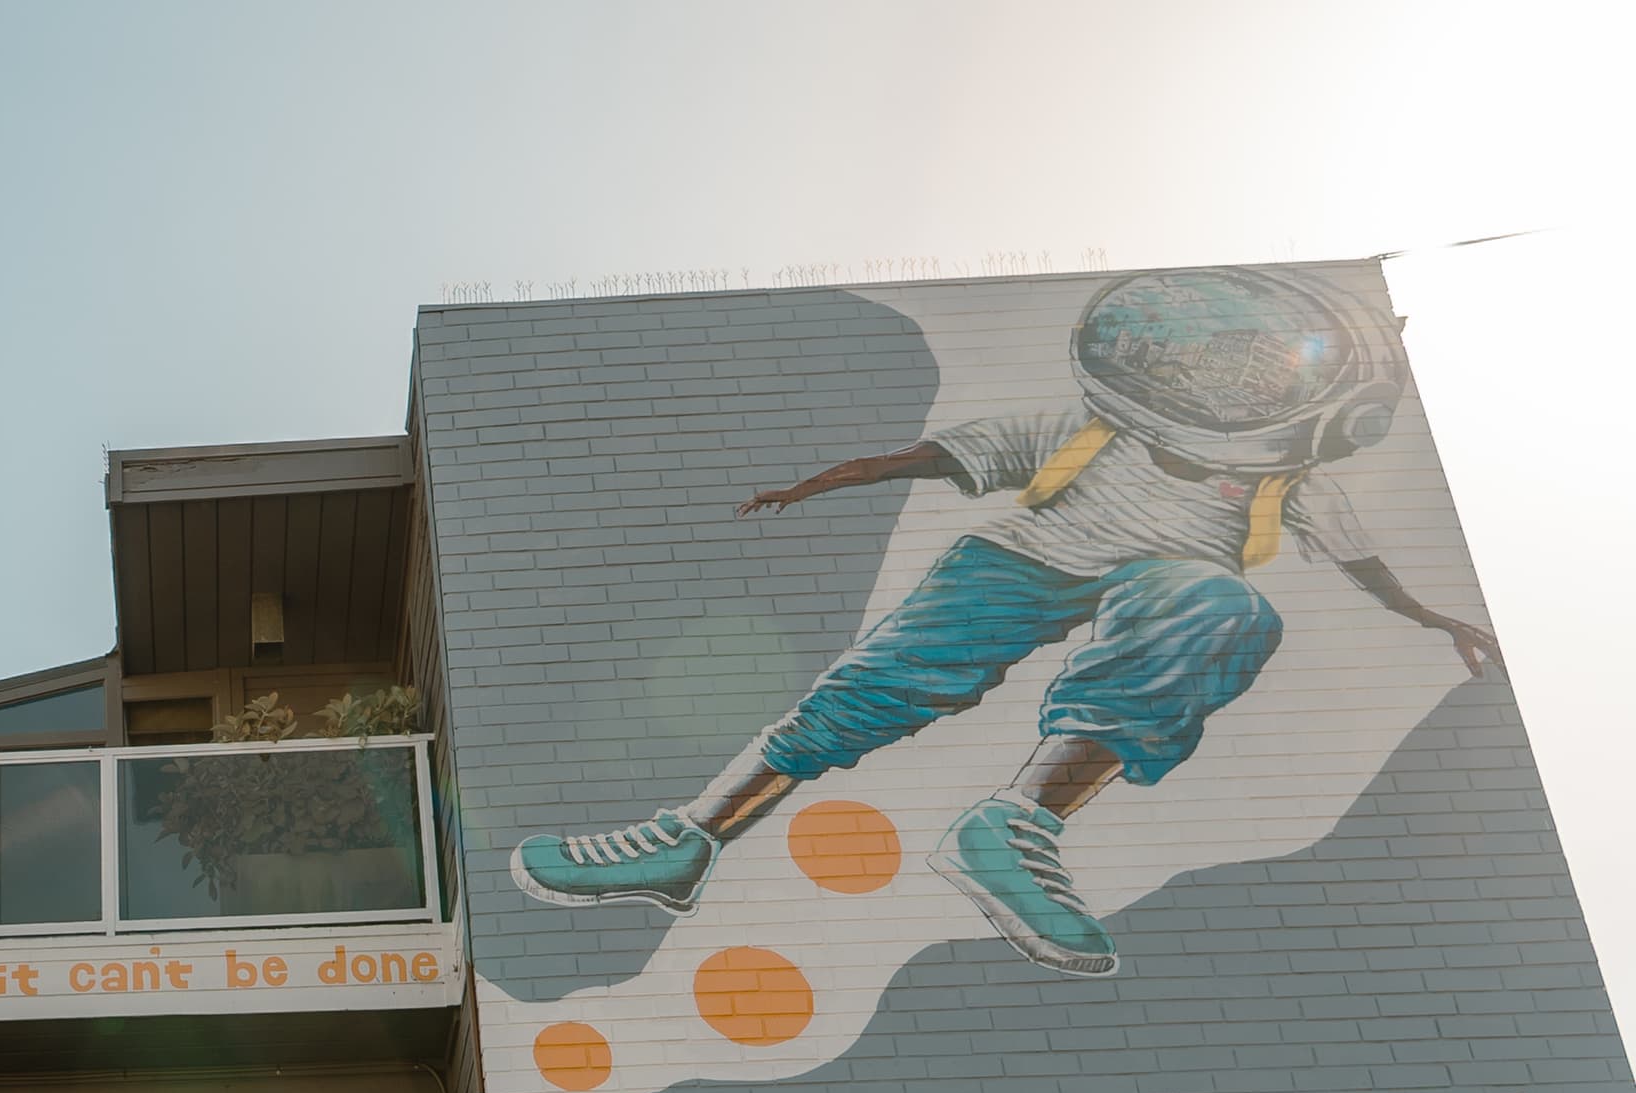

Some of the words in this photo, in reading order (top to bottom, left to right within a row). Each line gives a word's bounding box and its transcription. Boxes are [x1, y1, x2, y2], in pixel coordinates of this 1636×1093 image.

[69, 946, 193, 993] can't
[225, 949, 288, 988] be
[317, 945, 439, 985] done
